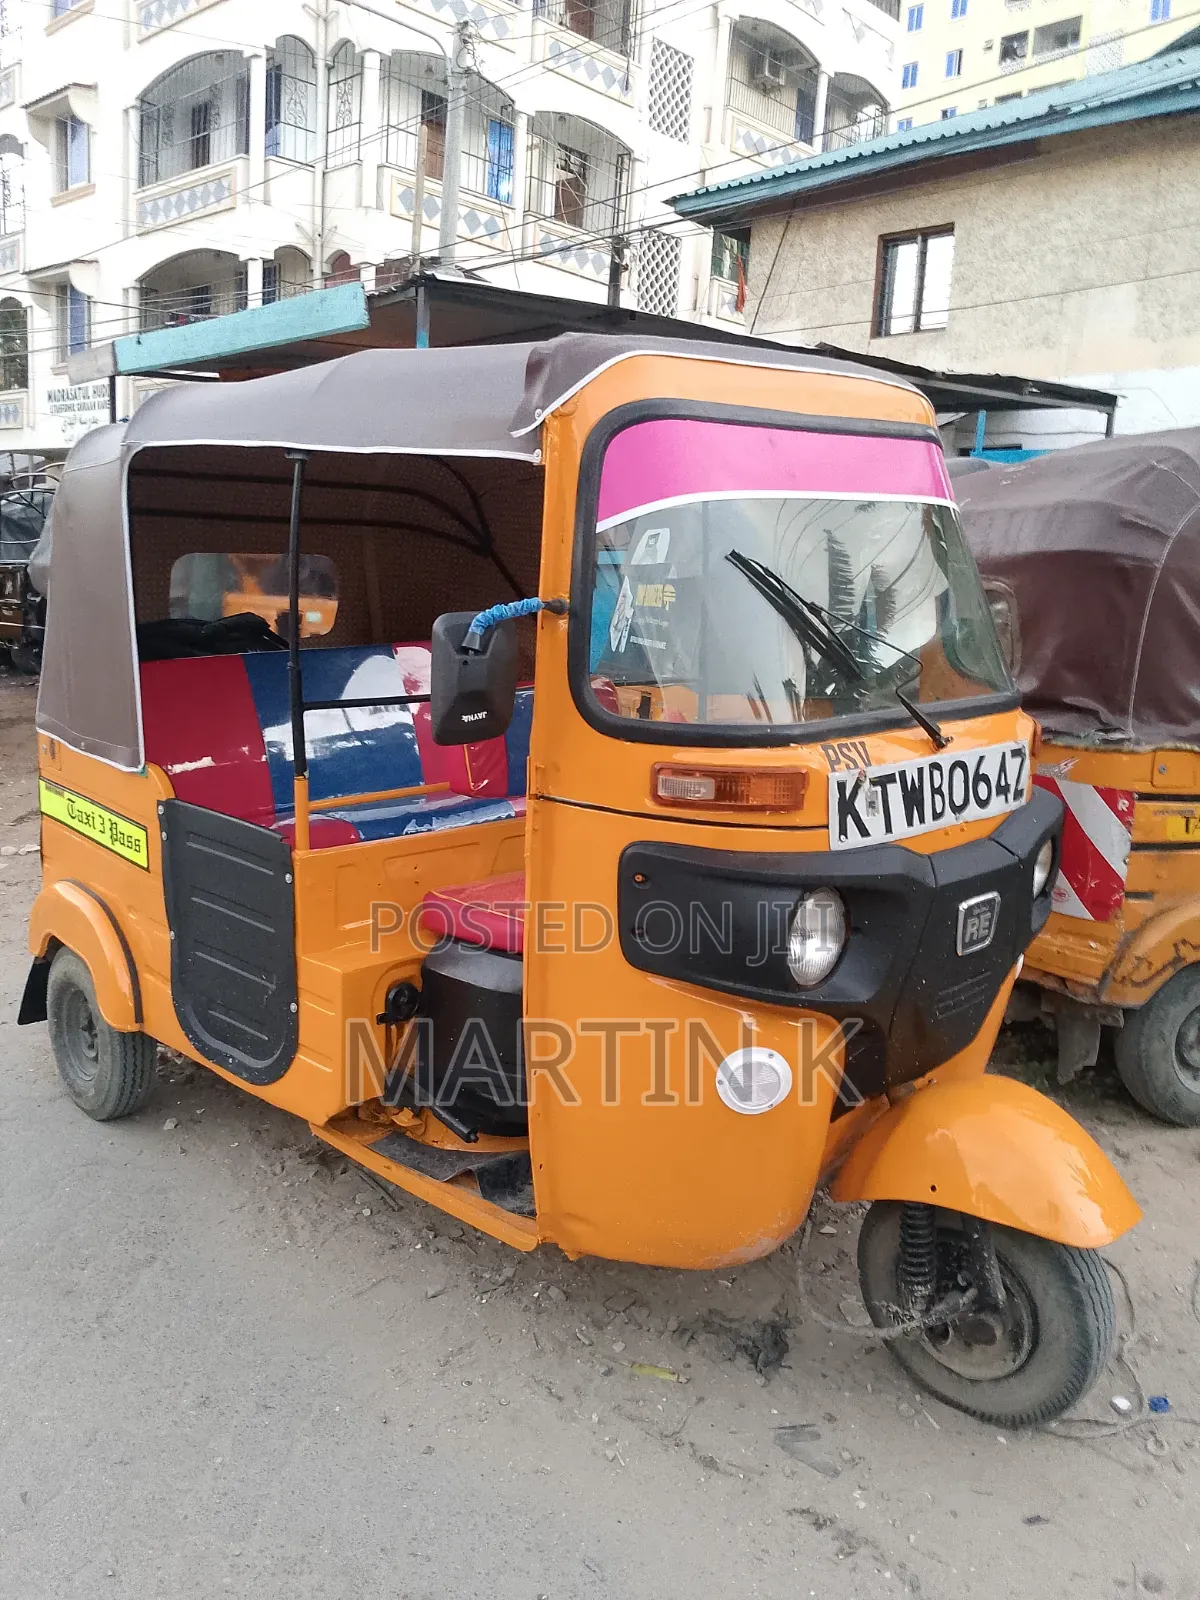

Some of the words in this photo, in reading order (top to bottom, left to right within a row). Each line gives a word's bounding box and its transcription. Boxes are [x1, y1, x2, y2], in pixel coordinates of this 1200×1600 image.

[47, 387, 90, 402] MADRASATUL
[821, 741, 872, 772] PSV
[66, 797, 97, 830] Taxi
[98, 814, 106, 834] 3
[108, 818, 142, 854] Pass
[964, 911, 992, 943] RE
